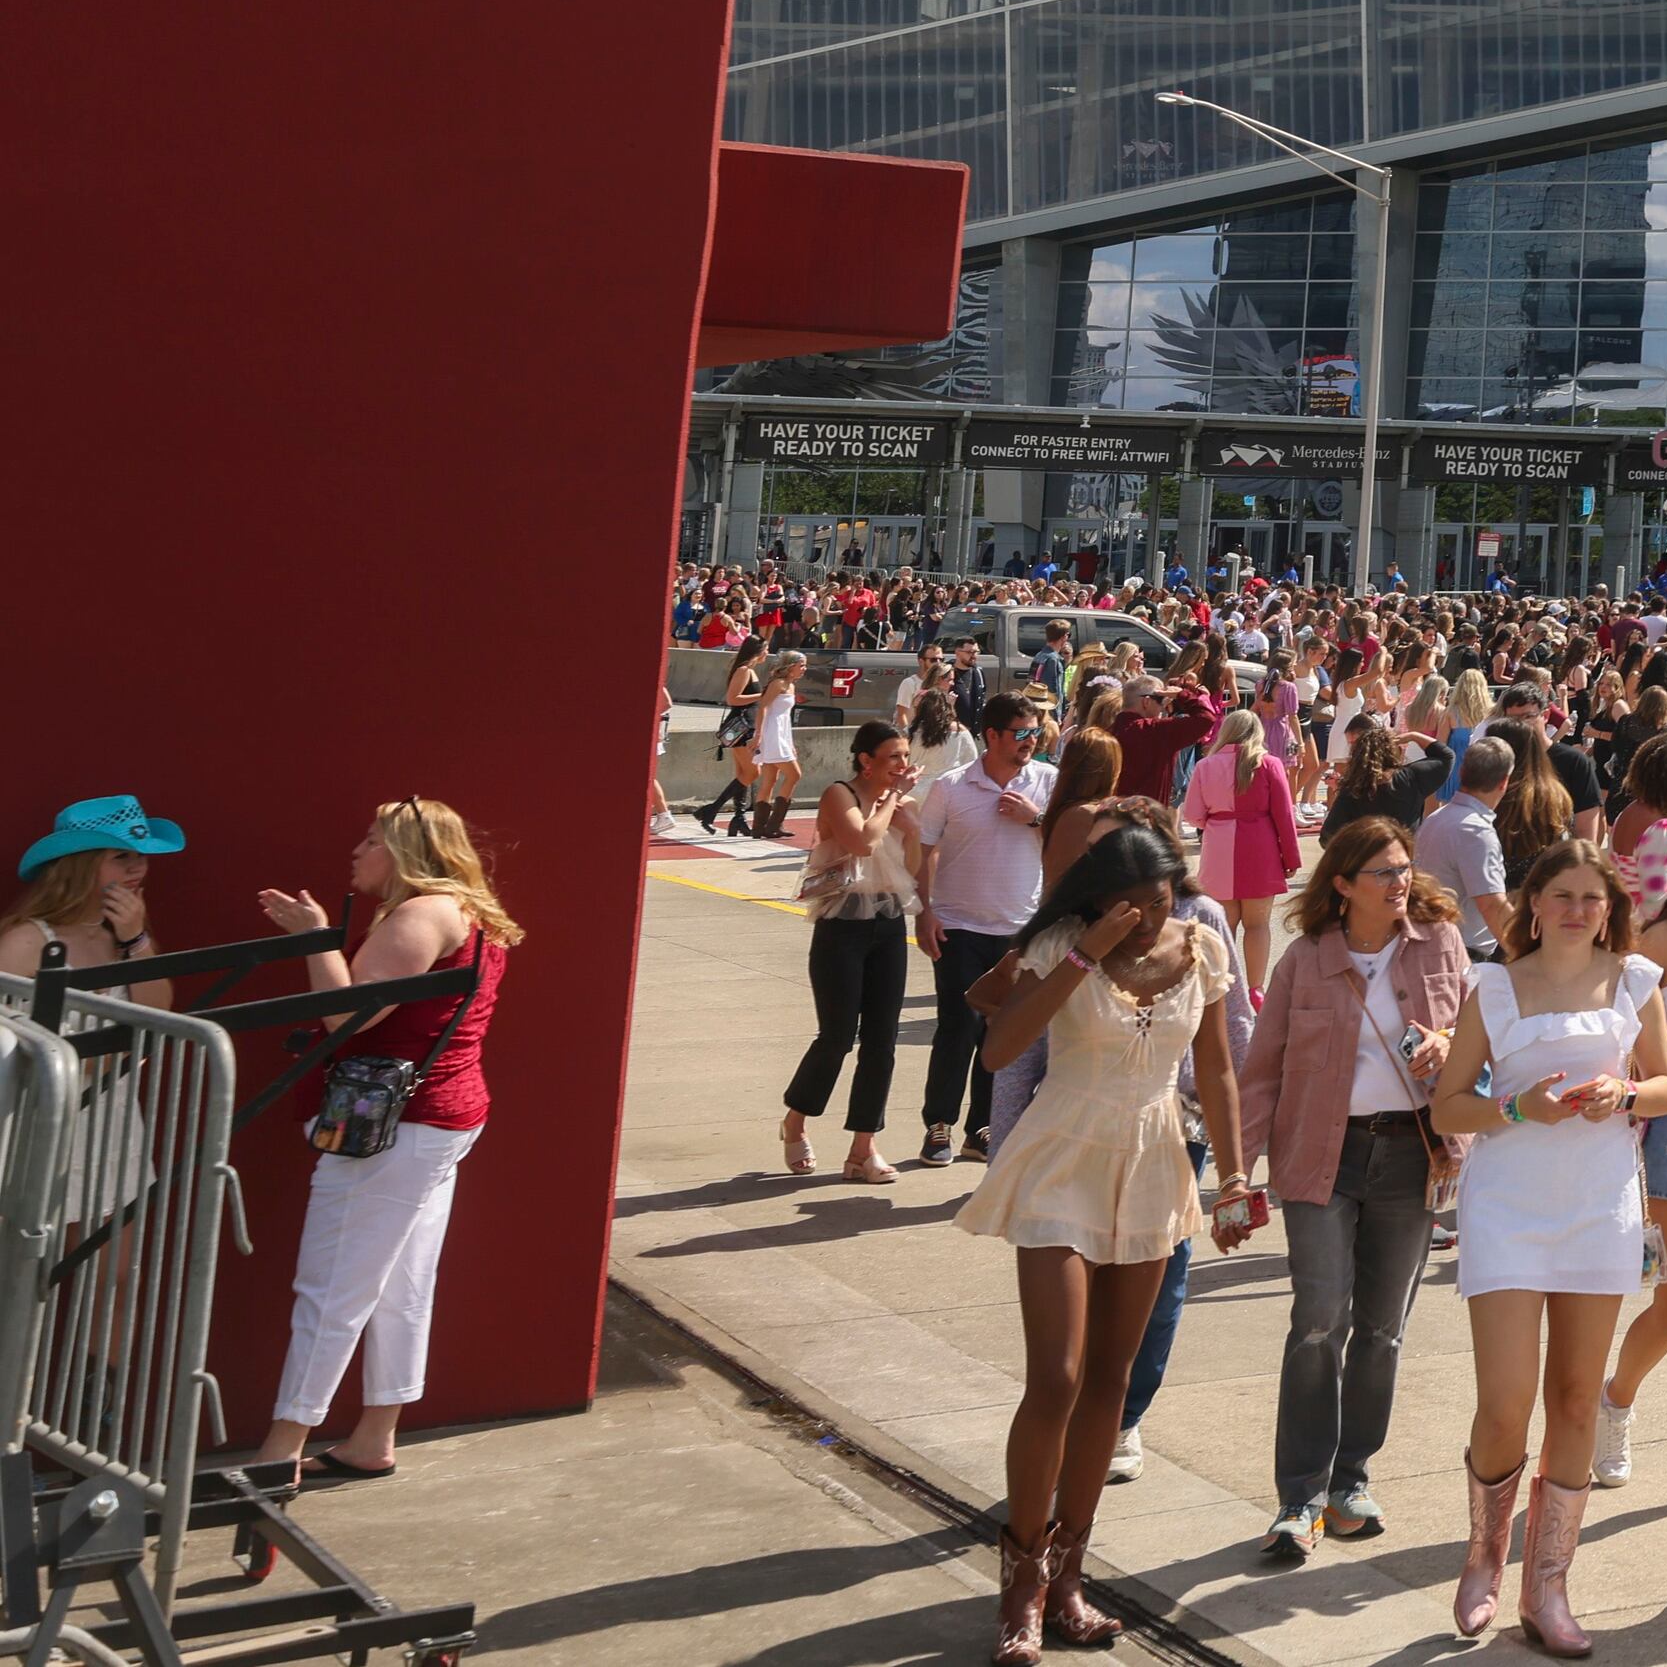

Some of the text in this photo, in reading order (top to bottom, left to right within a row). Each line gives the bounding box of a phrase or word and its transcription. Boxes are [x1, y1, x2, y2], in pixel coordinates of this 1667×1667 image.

[759, 423, 935, 441] HAVE YOUR TICKET
[773, 440, 918, 458] READY TO SCAN
[1013, 434, 1132, 449] FOR FASTER ENTRY
[971, 445, 1170, 463] CONNECT TO FREE WIFI: ATTWIFI
[1291, 445, 1391, 460] Mercedes-Bnz
[1434, 444, 1583, 464] HAVE YOUR TICKET
[1445, 461, 1569, 479] READY TO SCAN
